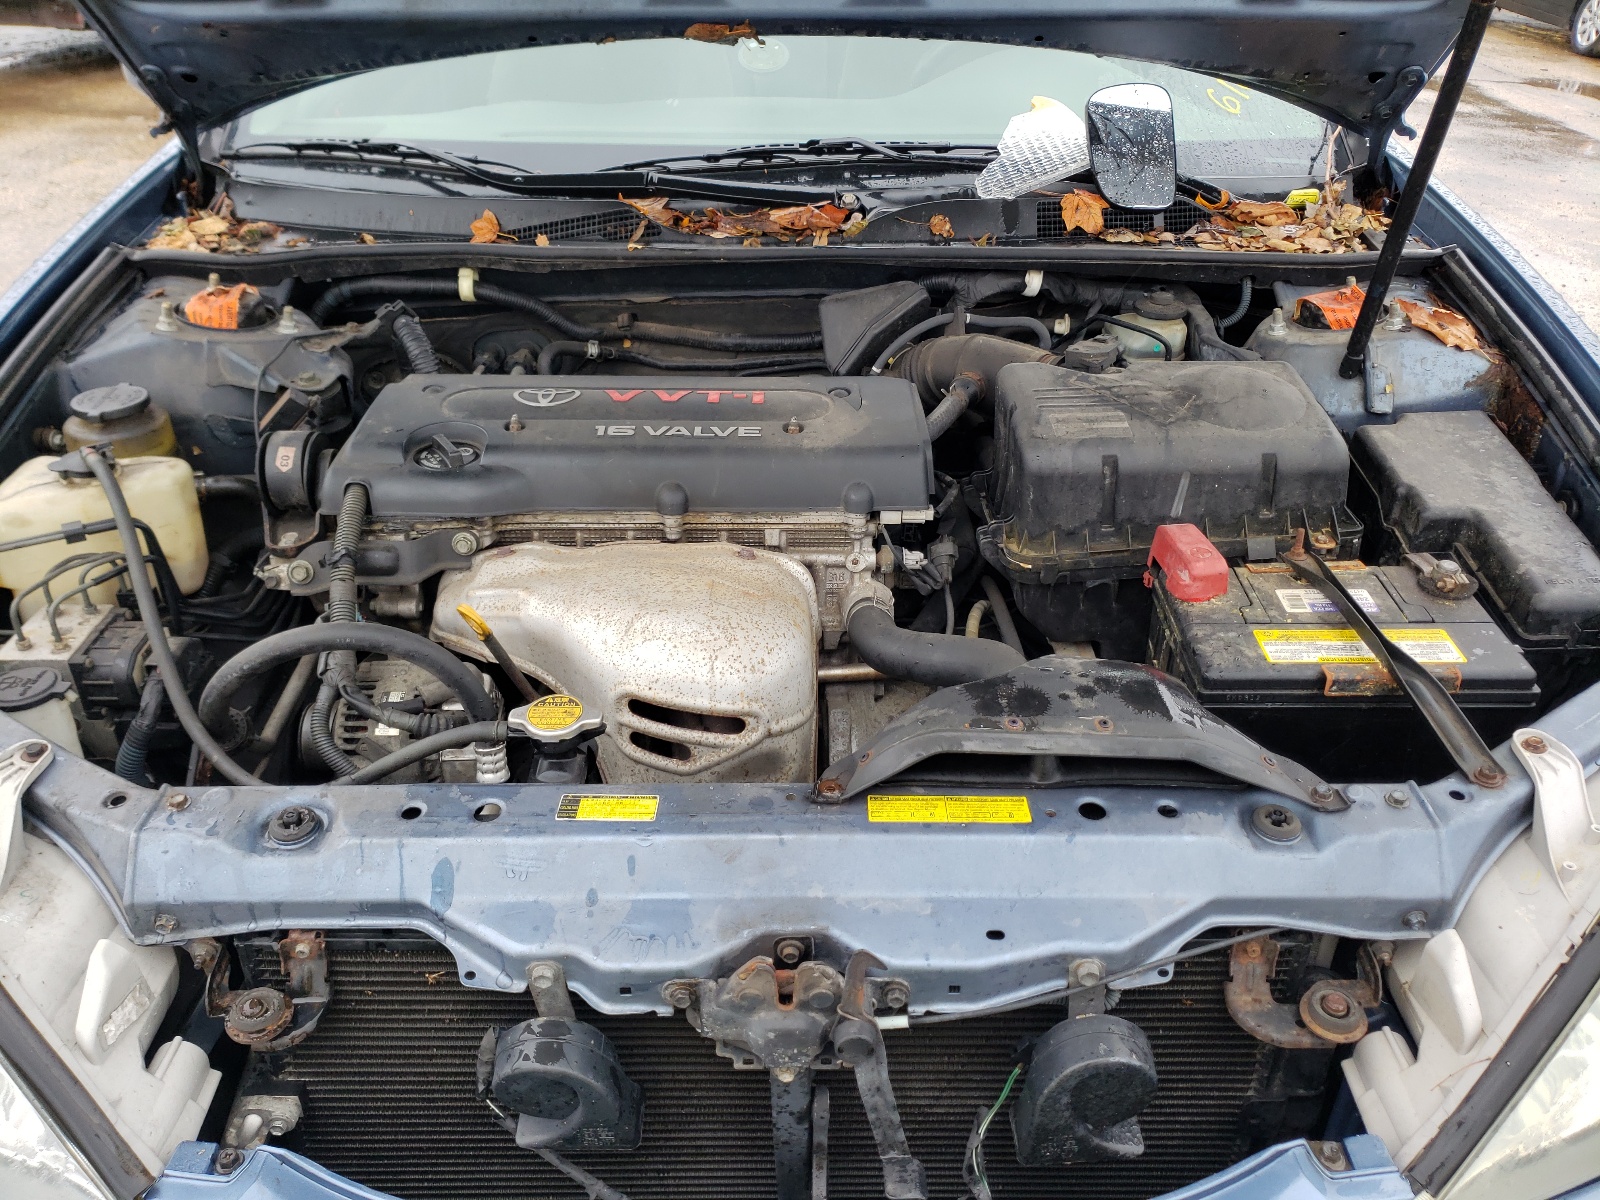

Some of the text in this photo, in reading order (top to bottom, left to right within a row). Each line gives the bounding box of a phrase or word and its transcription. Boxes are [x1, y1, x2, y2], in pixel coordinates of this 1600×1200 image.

[595, 425, 763, 437] 16 VALVE
[280, 454, 290, 468] 03
